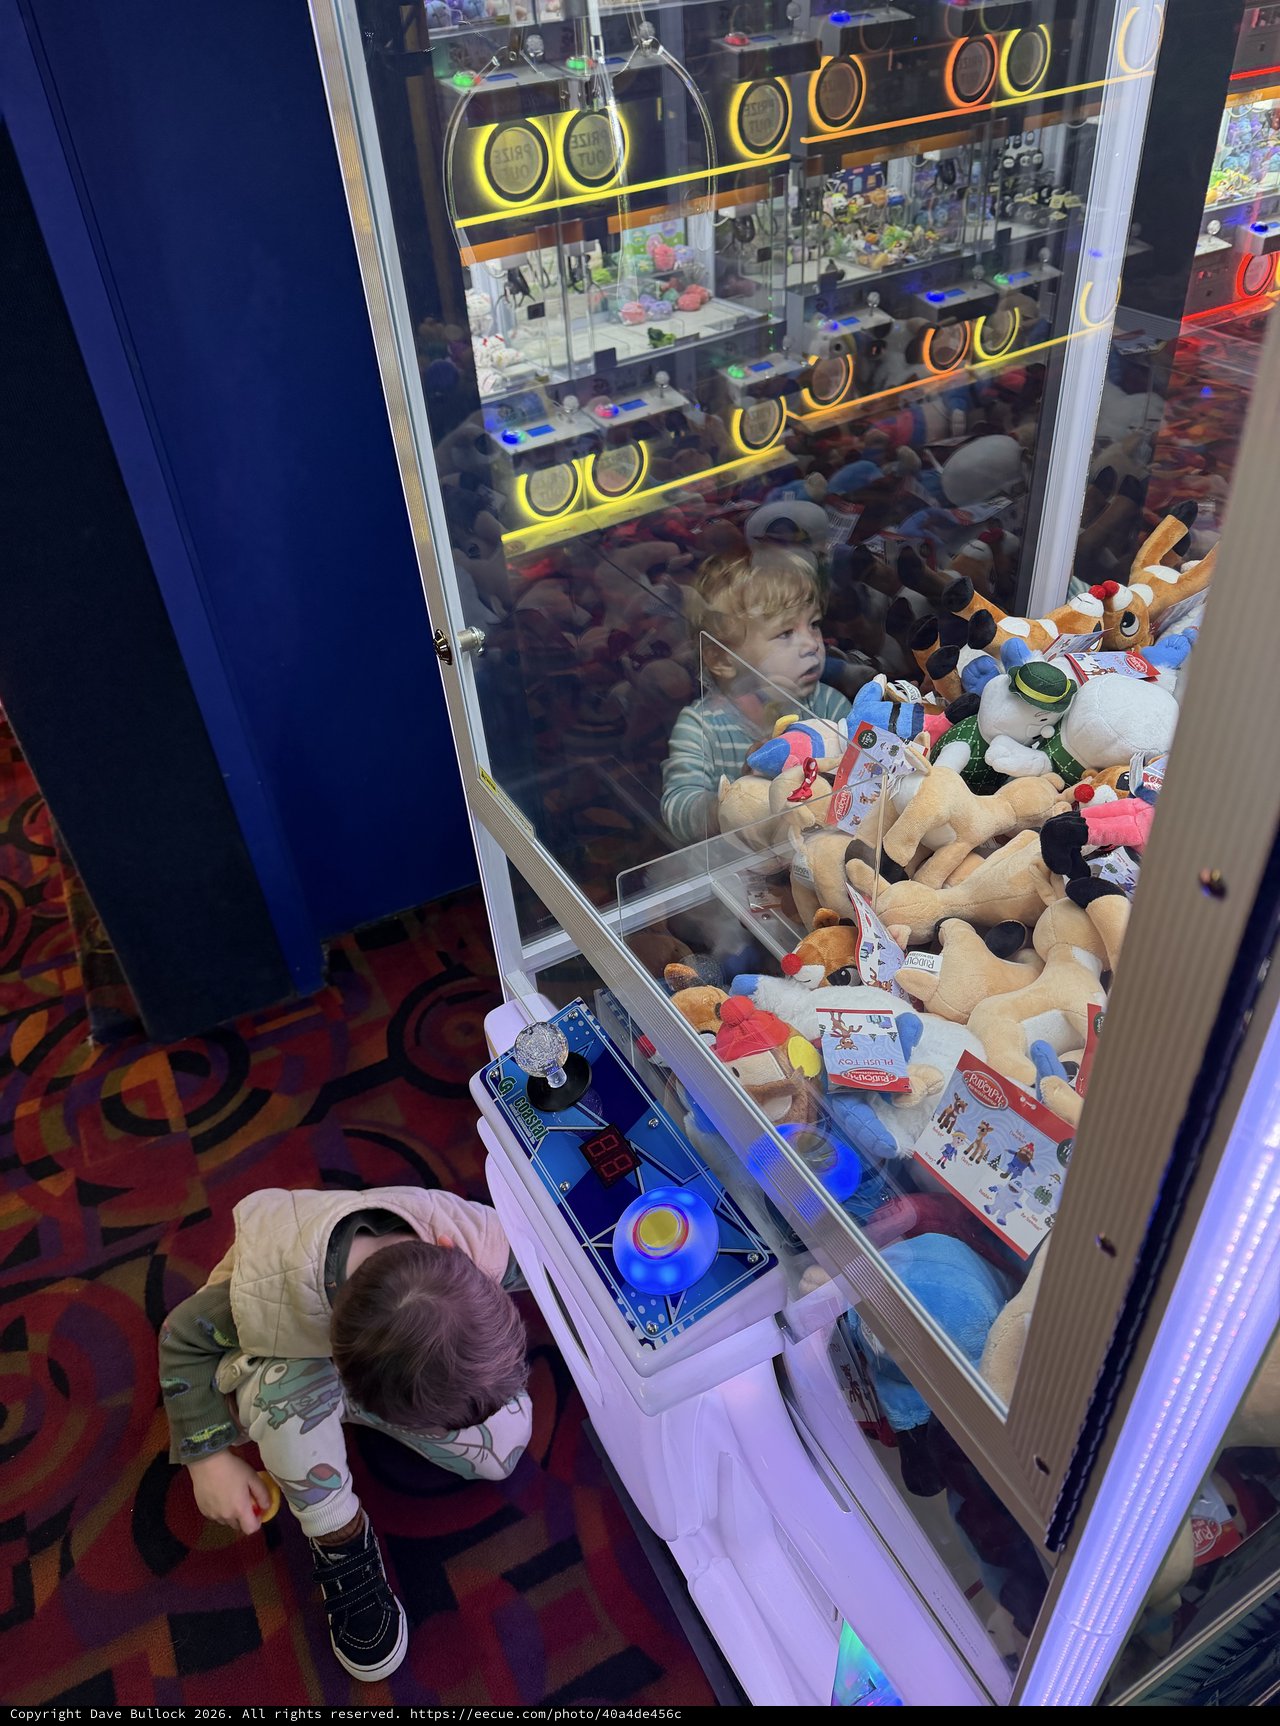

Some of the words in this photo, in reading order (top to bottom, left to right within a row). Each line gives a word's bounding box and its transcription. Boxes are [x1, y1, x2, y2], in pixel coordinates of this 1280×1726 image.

[904, 957, 935, 969] RUDOLP
[838, 1058, 860, 1066] TOY
[850, 1072, 890, 1083] RUDOLPH
[970, 1073, 1003, 1104] RUDOLPH
[514, 1096, 549, 1141] coastal
